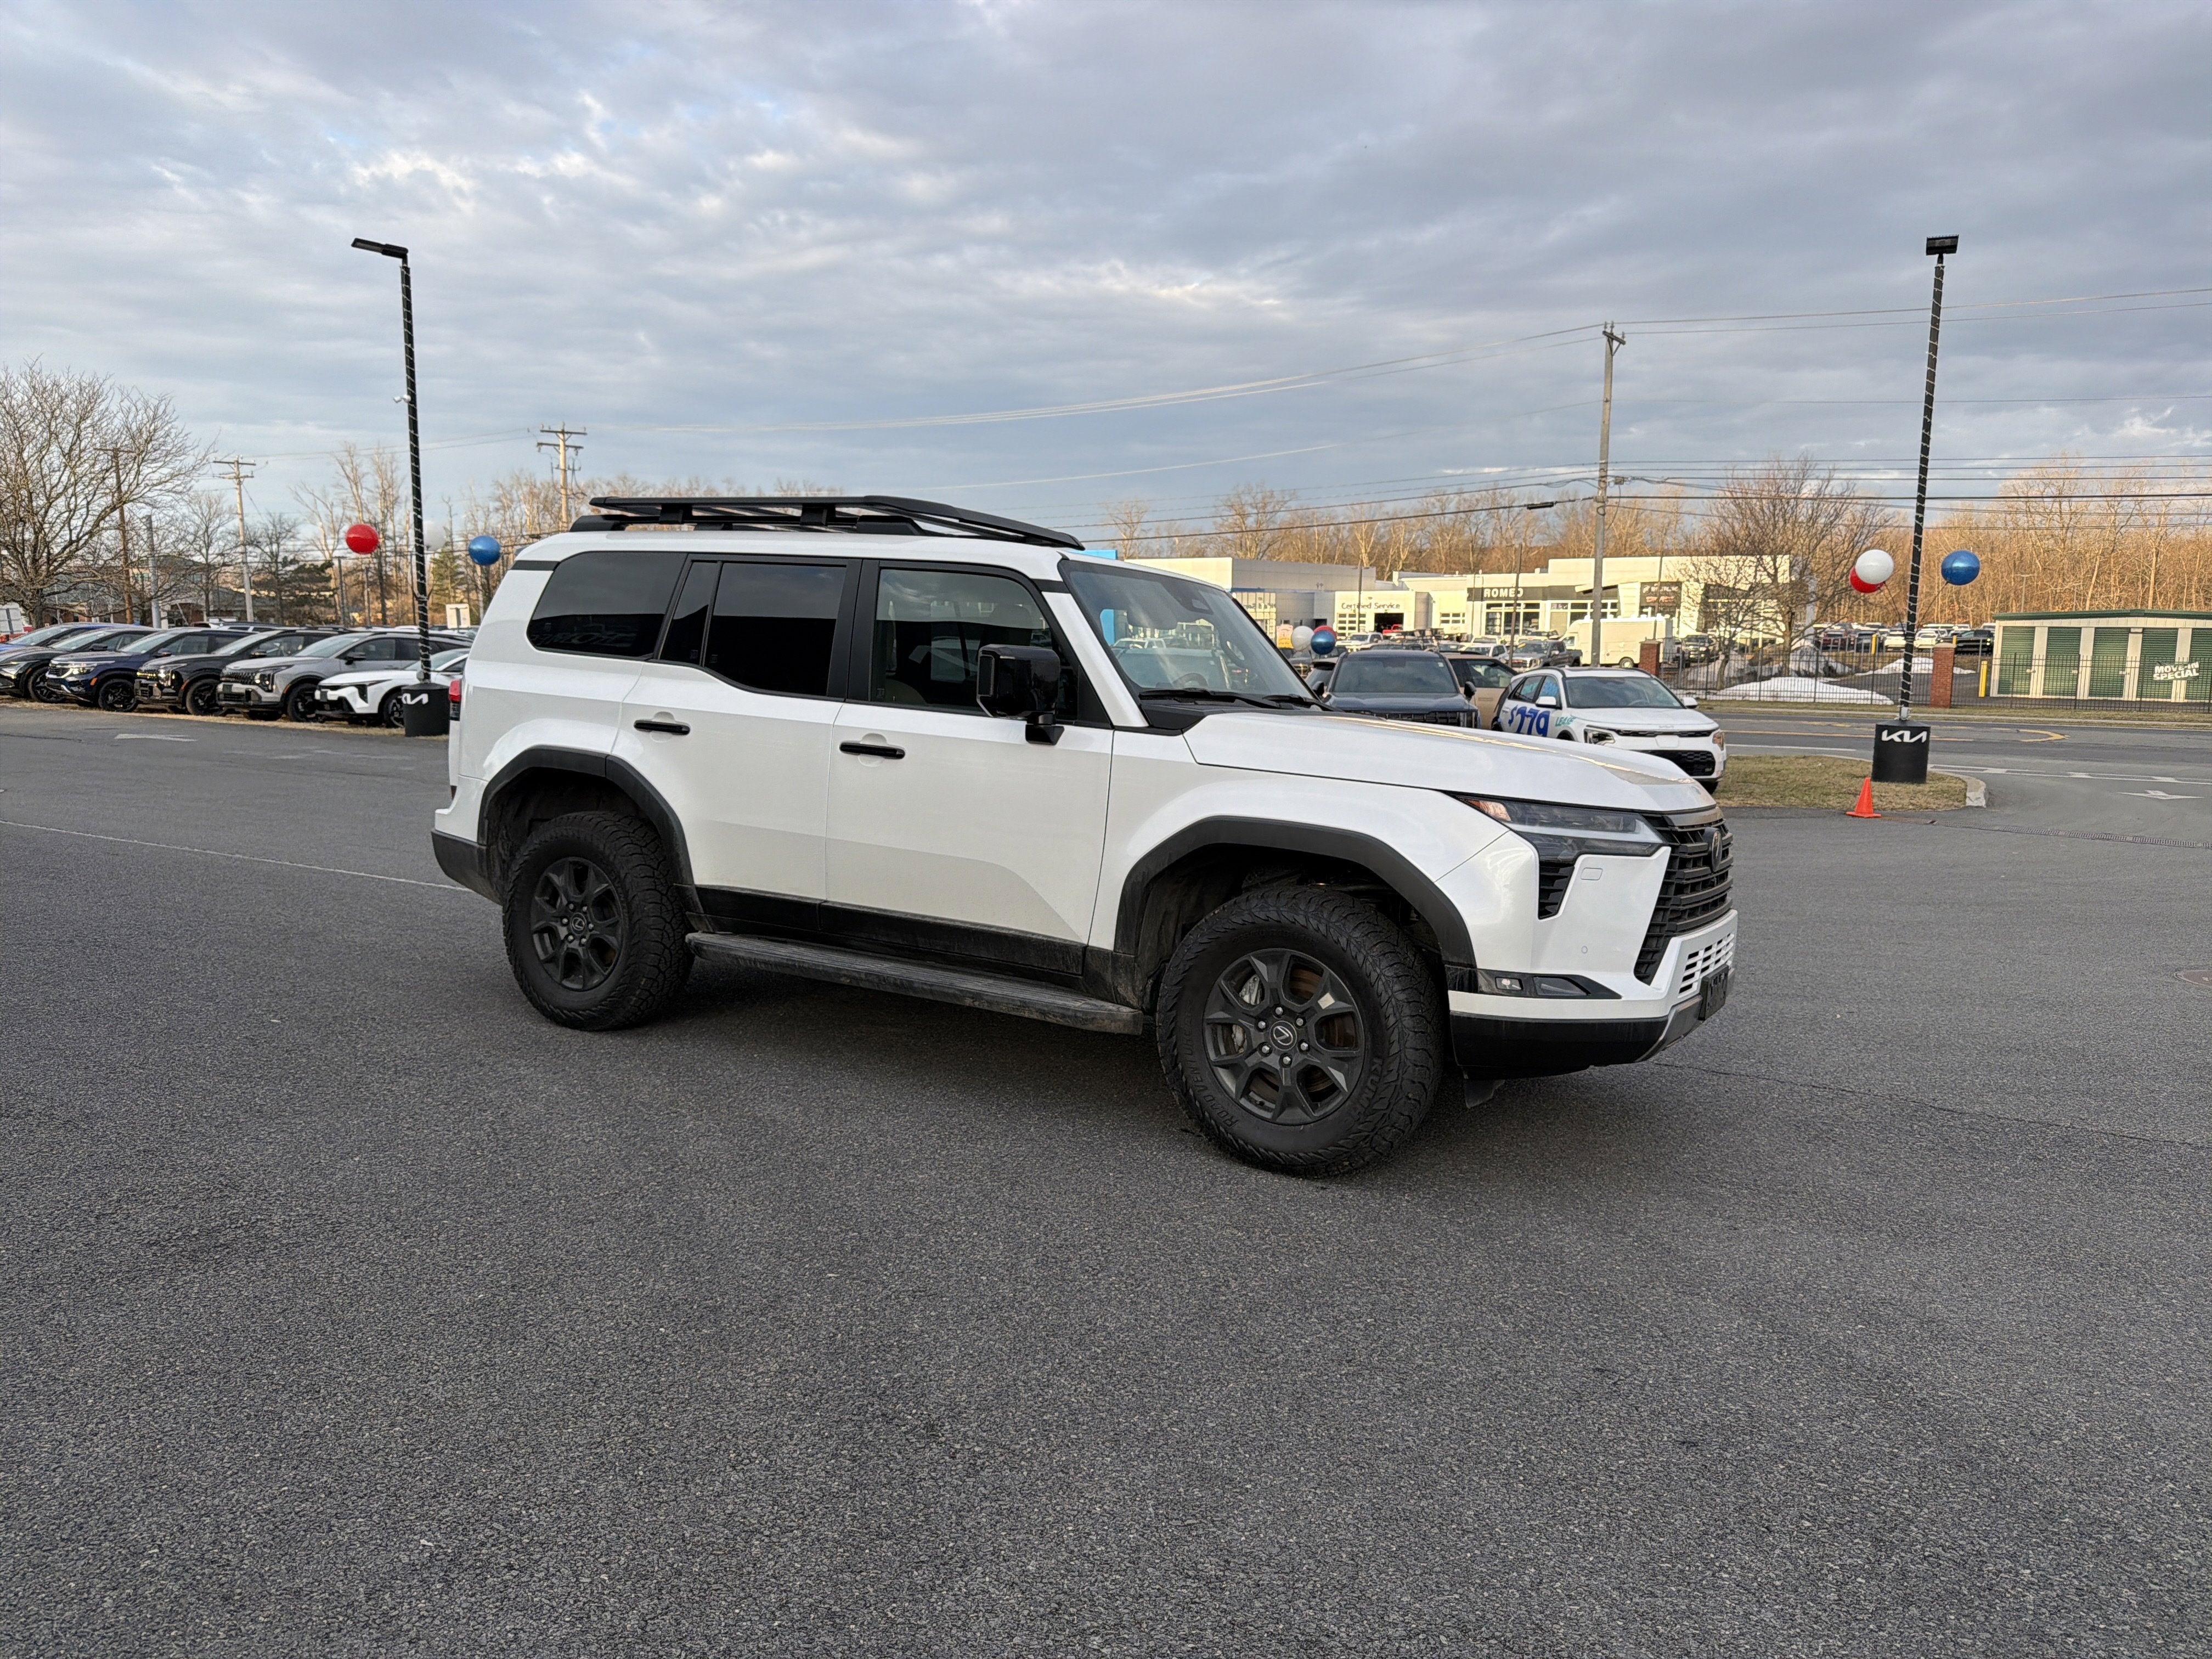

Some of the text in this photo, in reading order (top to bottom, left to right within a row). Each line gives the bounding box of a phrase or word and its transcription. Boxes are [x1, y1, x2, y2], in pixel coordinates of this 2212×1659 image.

[1483, 588, 1523, 598] ROMEO
[2154, 661, 2199, 674] MOVE-IN
[2153, 668, 2199, 680] SPECIAL
[1881, 729, 1927, 743] KIA
